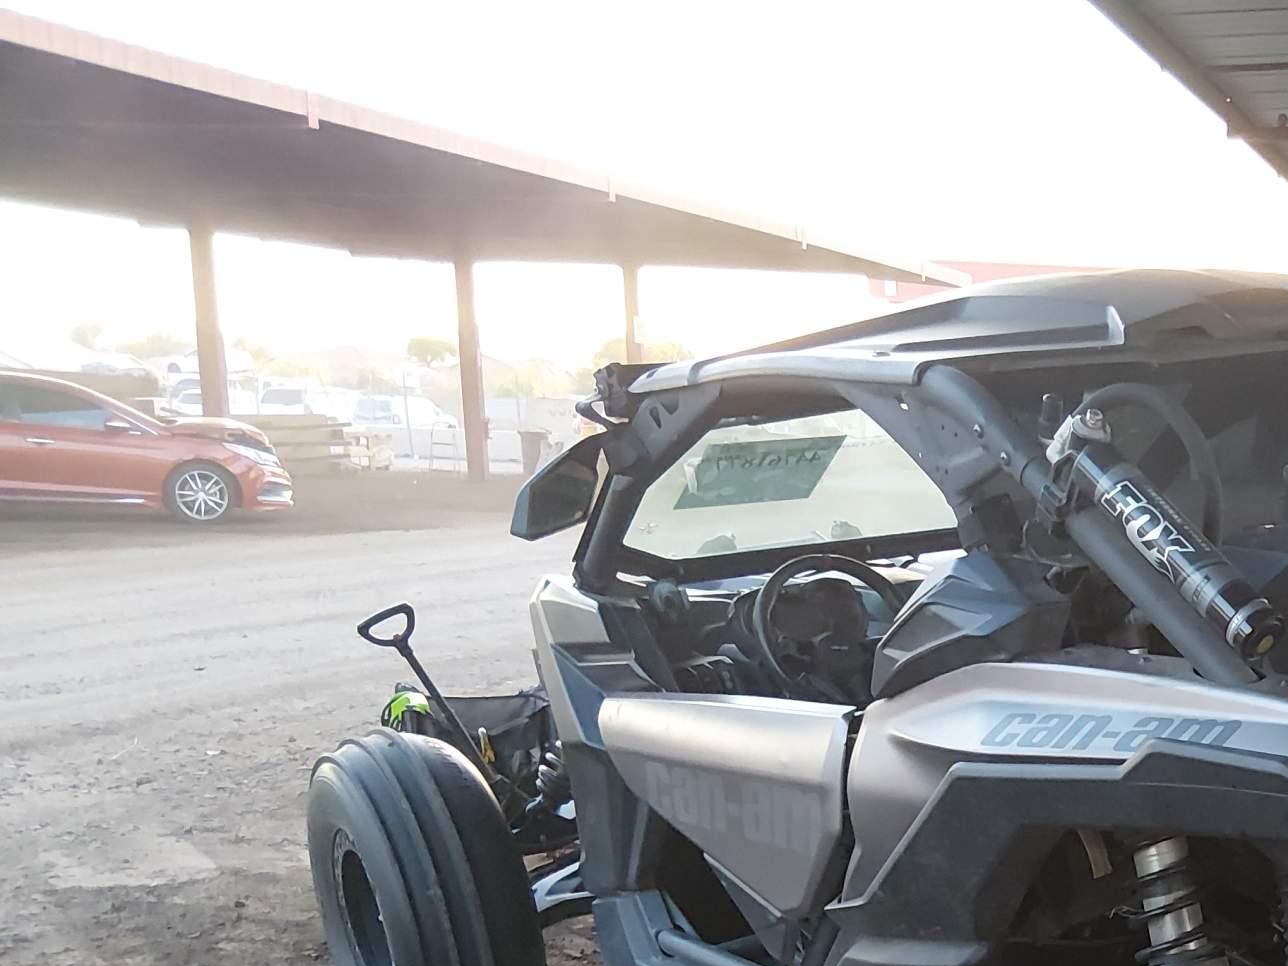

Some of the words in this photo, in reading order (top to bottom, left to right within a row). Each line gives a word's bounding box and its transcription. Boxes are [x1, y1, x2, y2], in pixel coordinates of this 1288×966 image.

[1101, 481, 1195, 583] FOX
[980, 713, 1242, 752] can-am
[645, 761, 825, 856] can-am
